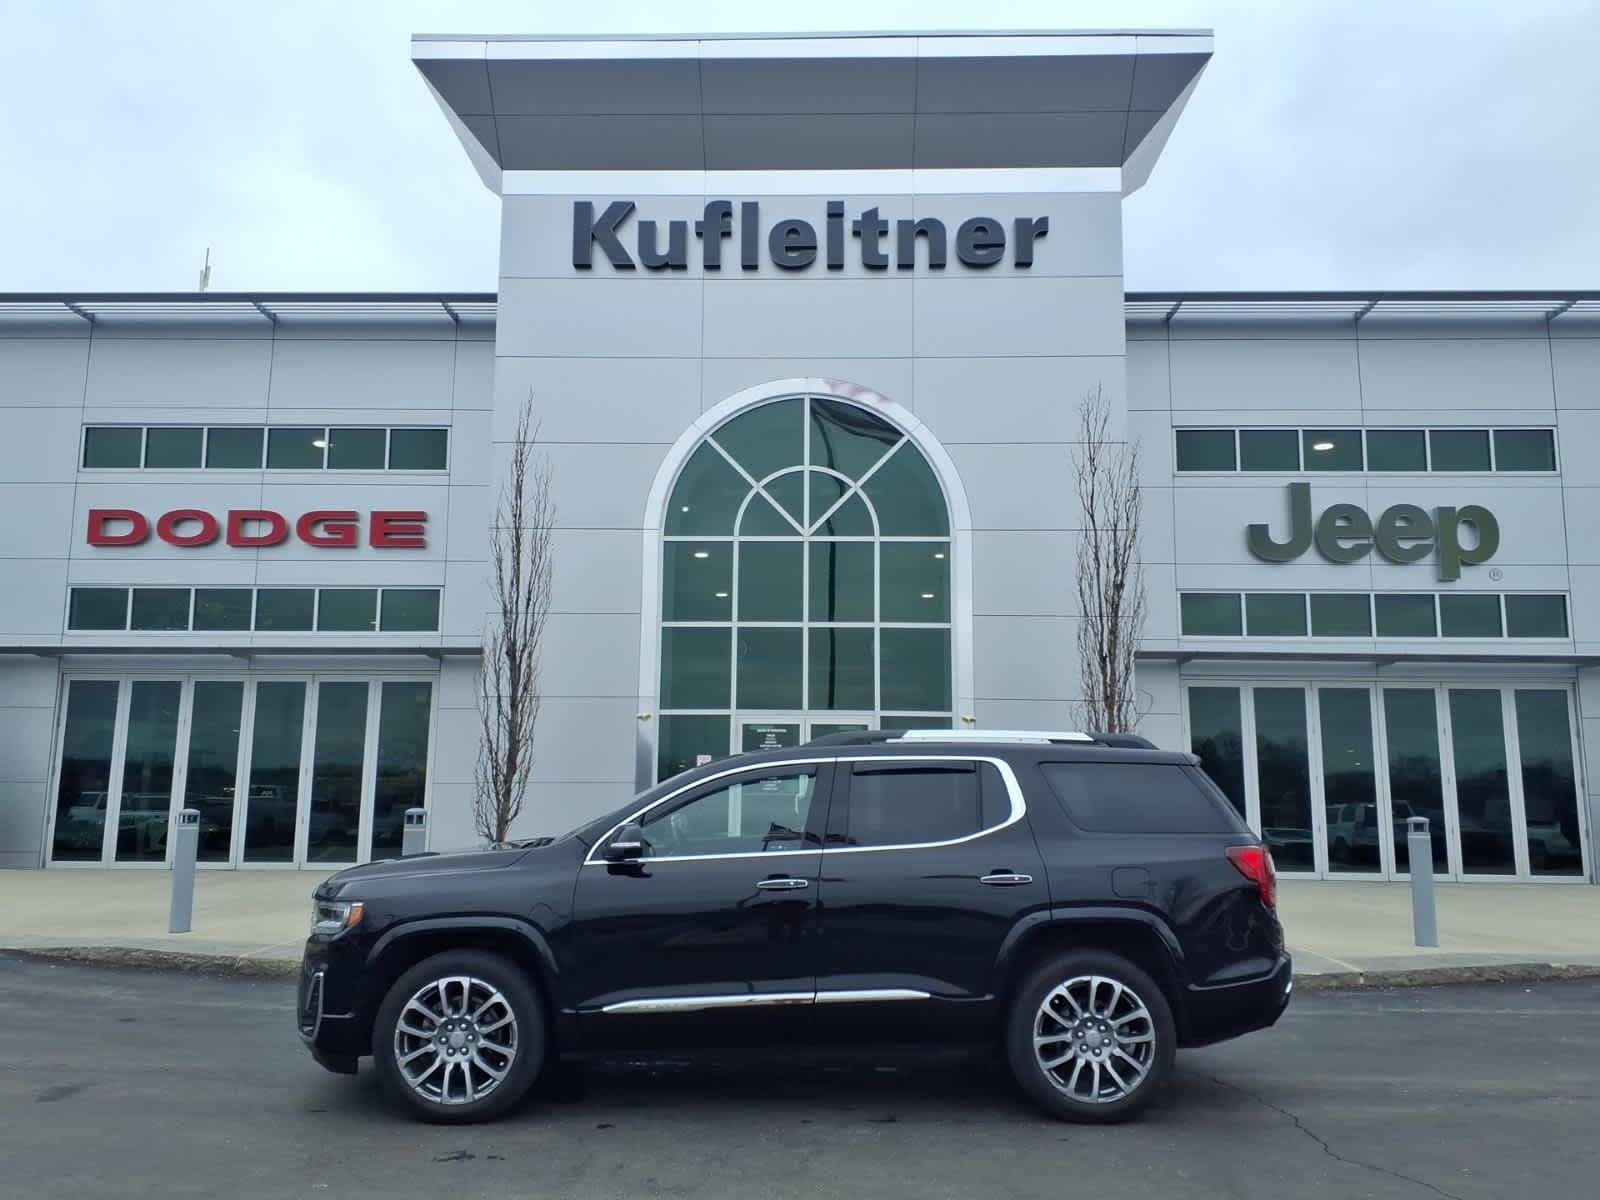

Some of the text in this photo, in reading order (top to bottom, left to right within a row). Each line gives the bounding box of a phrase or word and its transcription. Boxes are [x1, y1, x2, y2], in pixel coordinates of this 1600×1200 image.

[572, 199, 1049, 271] Kufleitner
[86, 508, 428, 548] DODGE
[1247, 482, 1500, 582] Jeep
